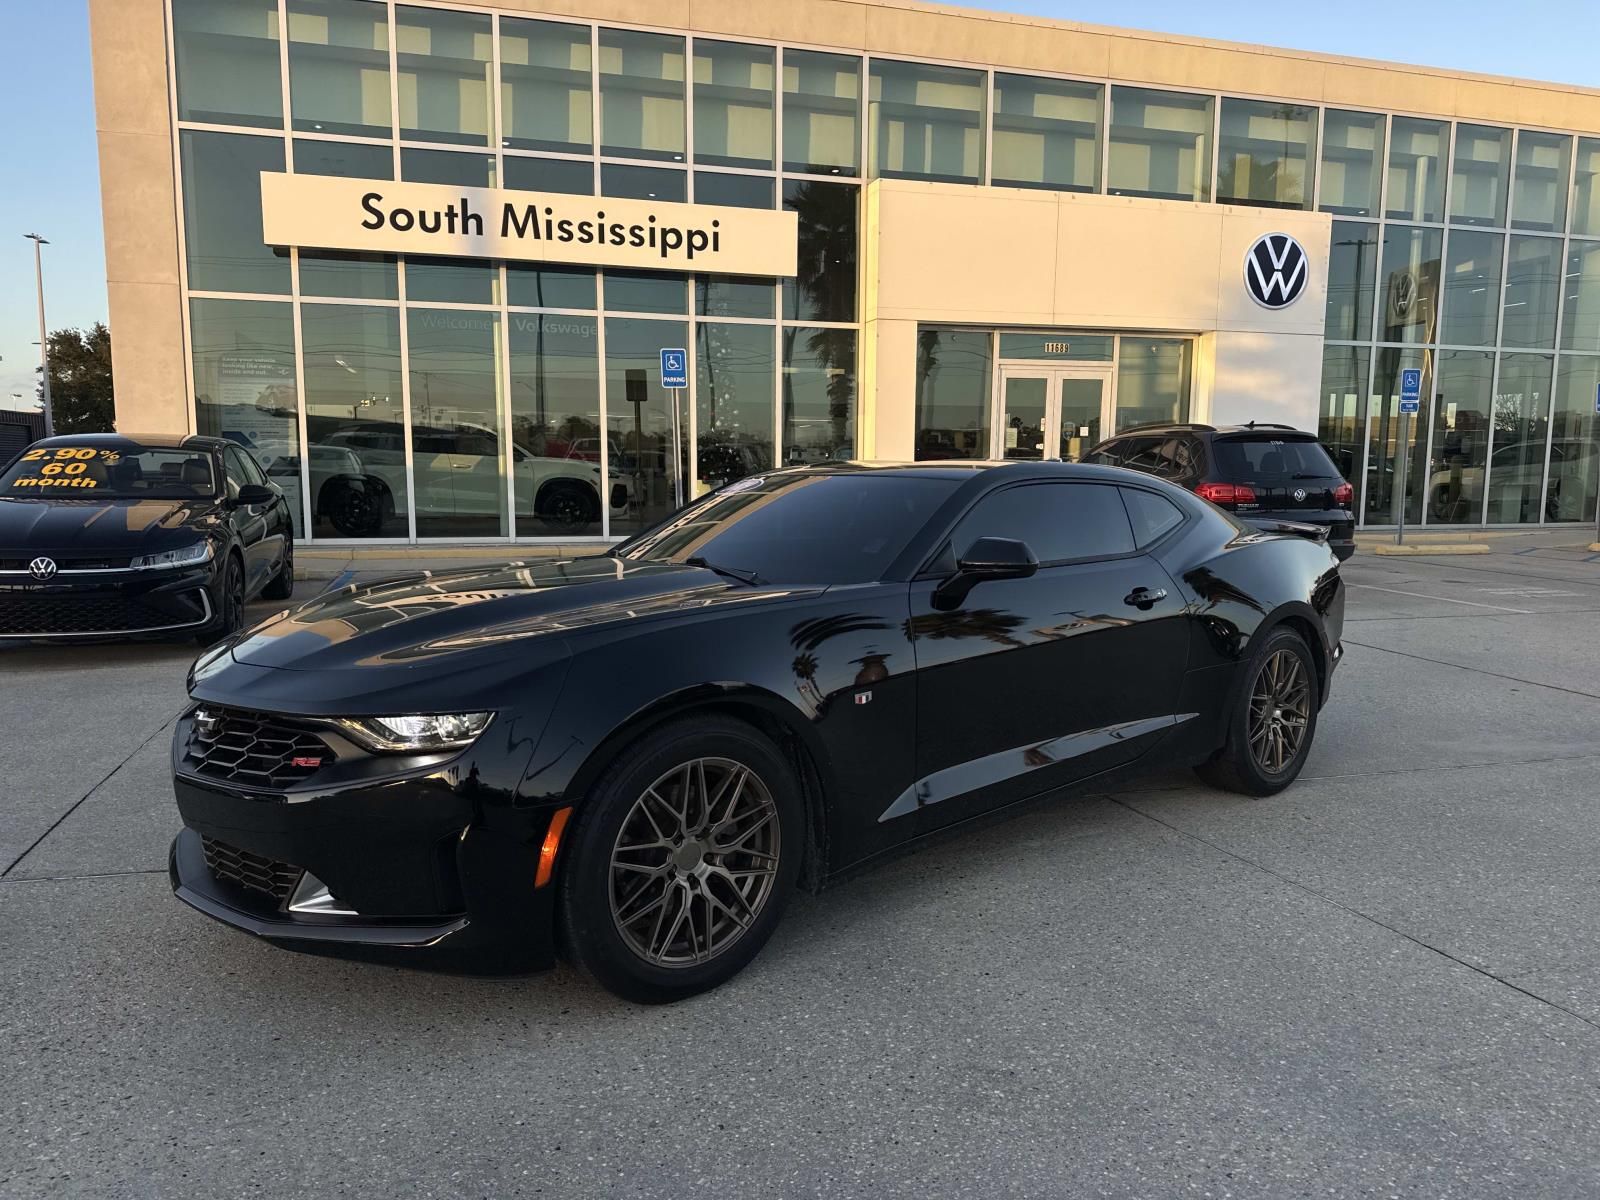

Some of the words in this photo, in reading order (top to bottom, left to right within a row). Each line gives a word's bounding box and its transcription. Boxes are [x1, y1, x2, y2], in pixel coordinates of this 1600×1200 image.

[361, 192, 484, 236] South
[500, 202, 720, 260] Mississippi
[421, 311, 493, 331] Welcome
[1045, 343, 1069, 353] 11689
[41, 462, 87, 475] 60
[13, 477, 97, 488] month
[291, 757, 321, 767] RS
